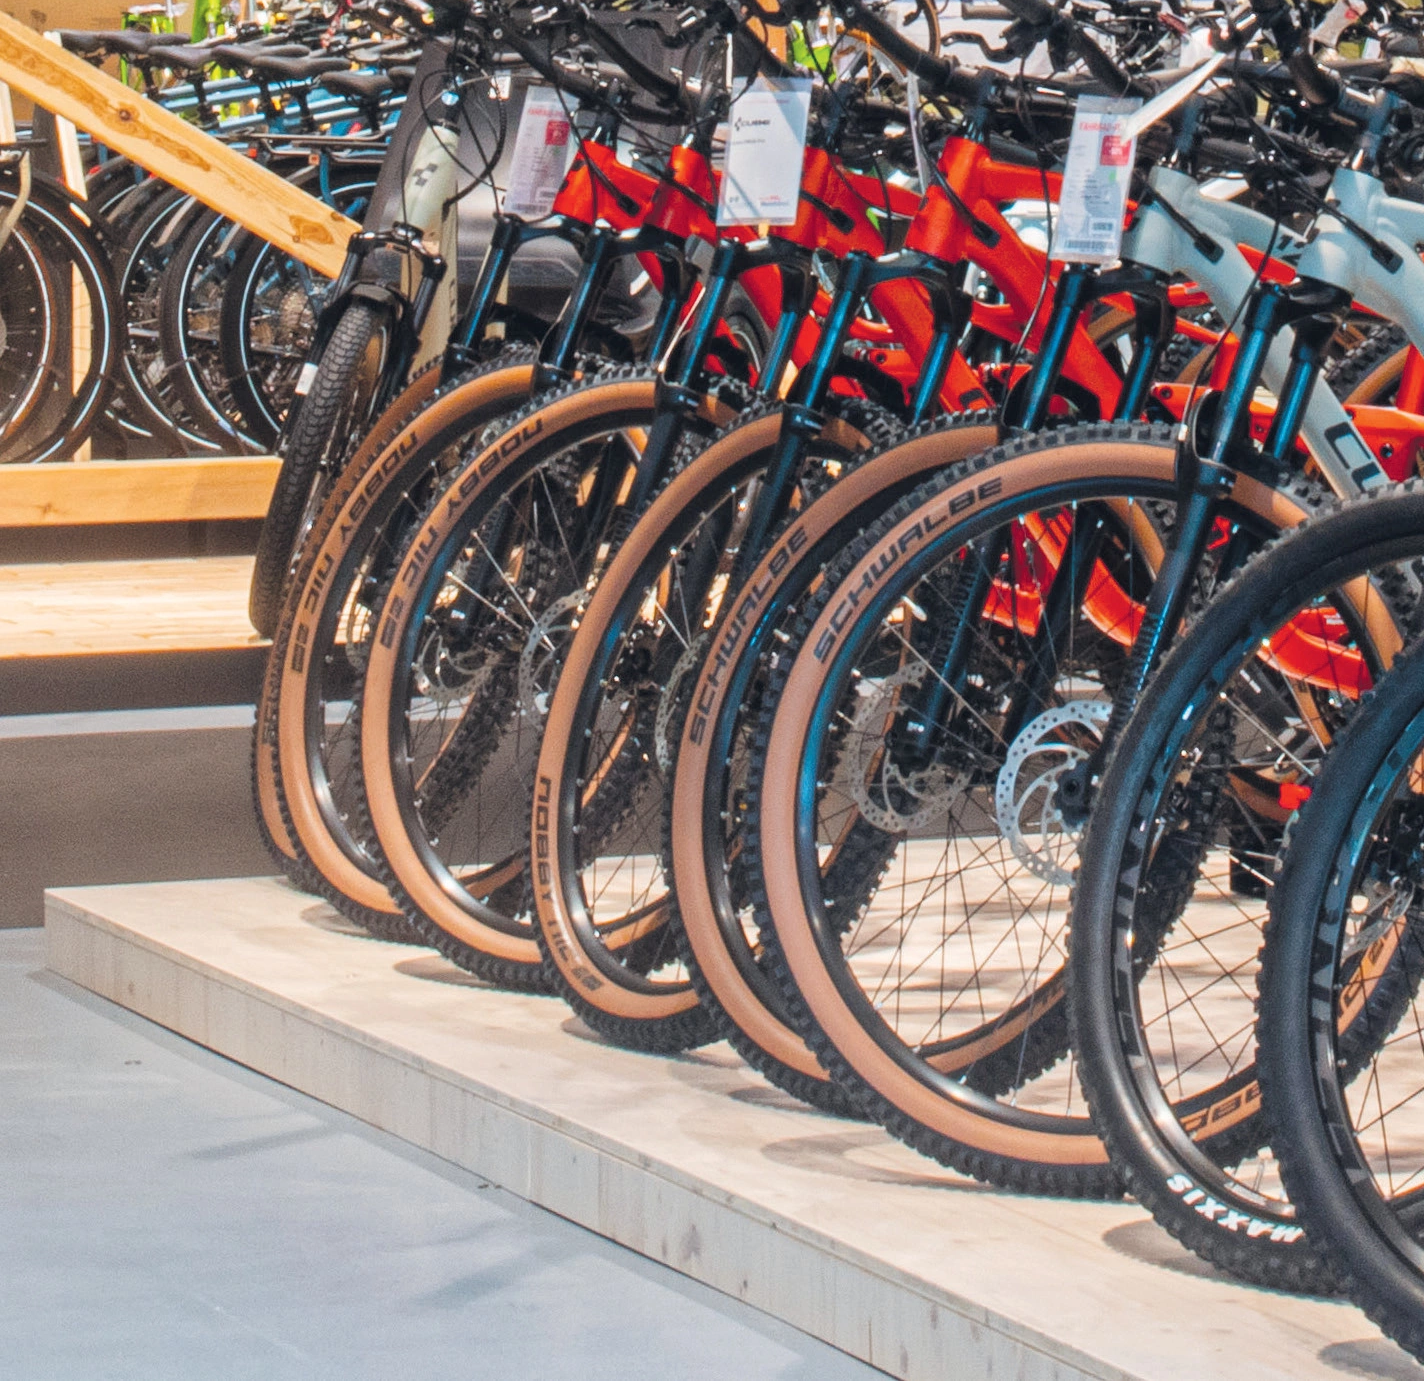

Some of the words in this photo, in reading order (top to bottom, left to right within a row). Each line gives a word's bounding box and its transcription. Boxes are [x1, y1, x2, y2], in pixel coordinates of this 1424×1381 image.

[339, 431, 418, 544] NOBBY
[447, 418, 543, 518] NOBBY
[305, 551, 335, 615] NIC
[402, 525, 438, 588] NIC
[814, 476, 1002, 664] SCHWALBE
[690, 526, 808, 746] SCHWALBE
[536, 776, 552, 902] NOBBY
[1166, 1174, 1305, 1244] MAXXIS
